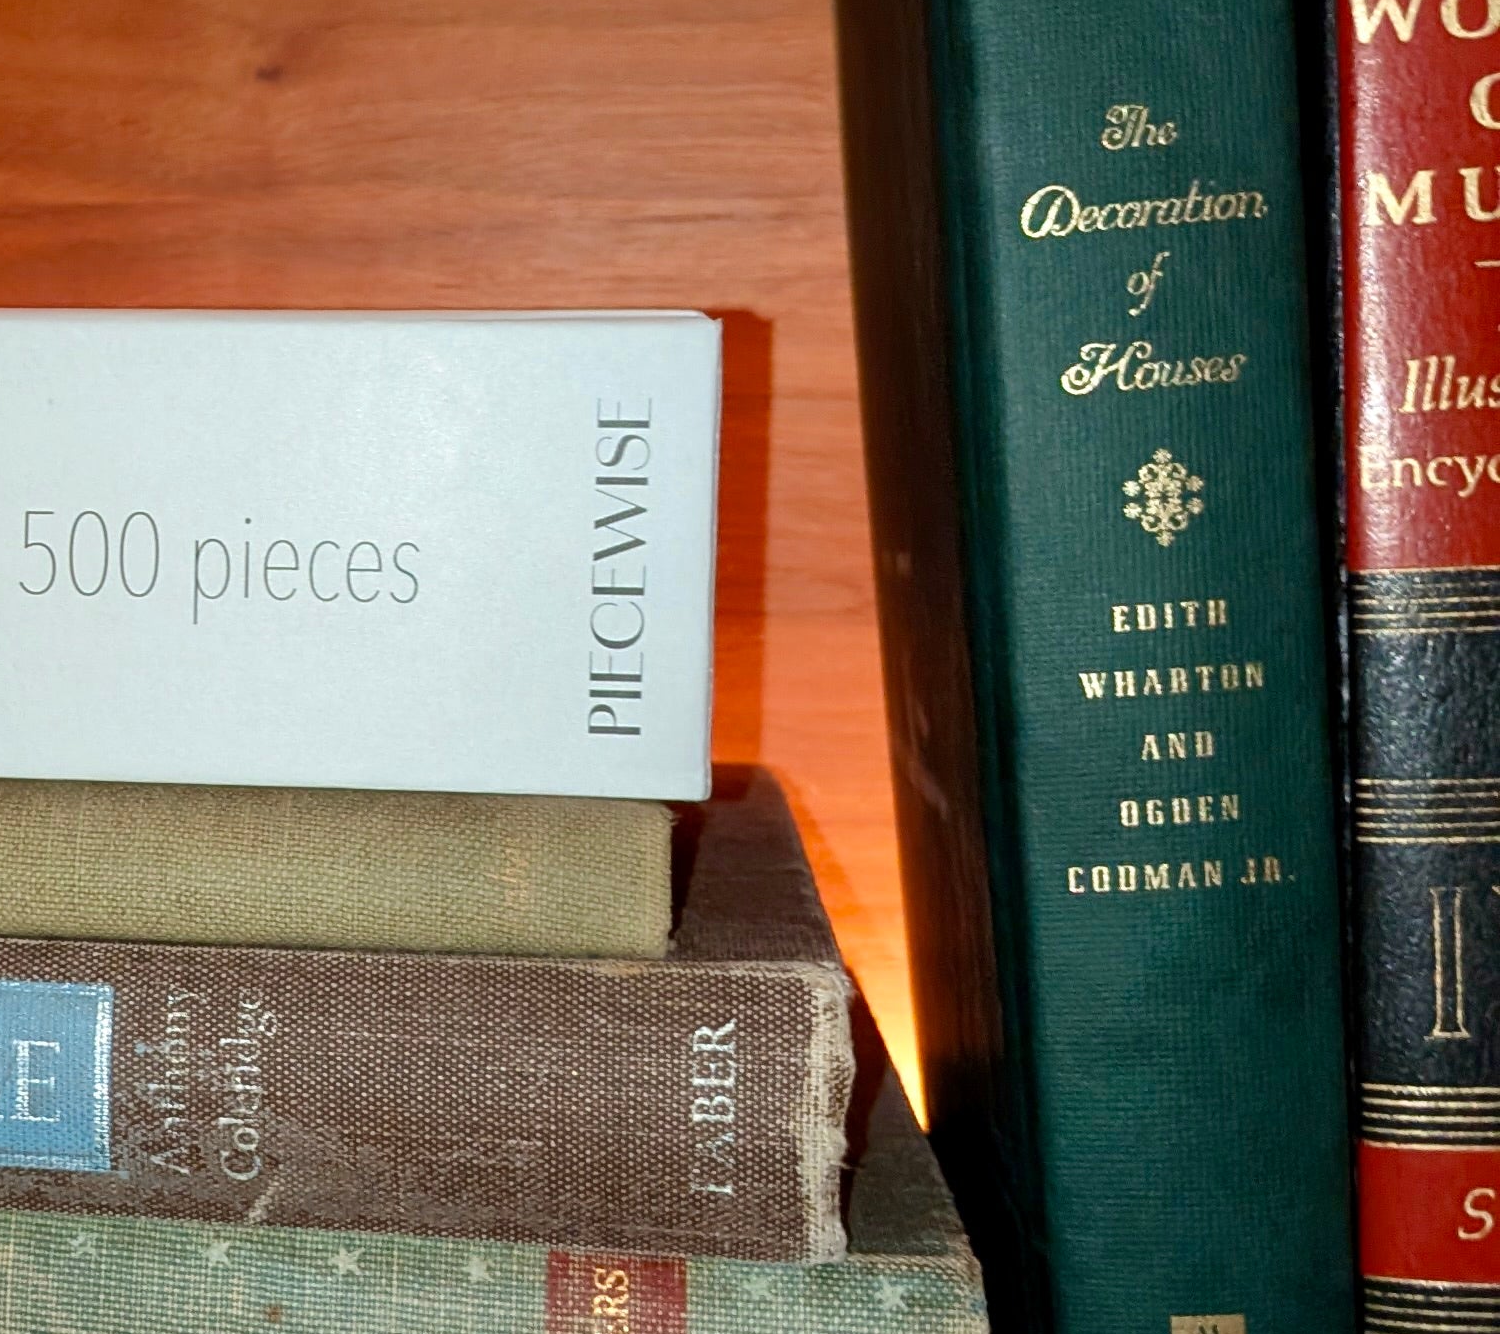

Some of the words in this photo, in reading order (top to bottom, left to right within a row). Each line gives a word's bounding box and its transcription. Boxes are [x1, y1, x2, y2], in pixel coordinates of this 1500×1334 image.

[1101, 103, 1179, 150] The
[1019, 180, 1268, 239] Decoration
[1126, 251, 1168, 317] of
[1060, 341, 1247, 396] Houses
[18, 510, 161, 597] 500
[192, 517, 421, 625] pieces
[587, 396, 653, 736] PIECEWISE
[1111, 599, 1228, 634] EDITH
[1078, 661, 1266, 699] WHARTON
[1140, 732, 1216, 762] AND
[1119, 794, 1242, 829] OGDEN
[1066, 861, 1225, 896] CODMAN
